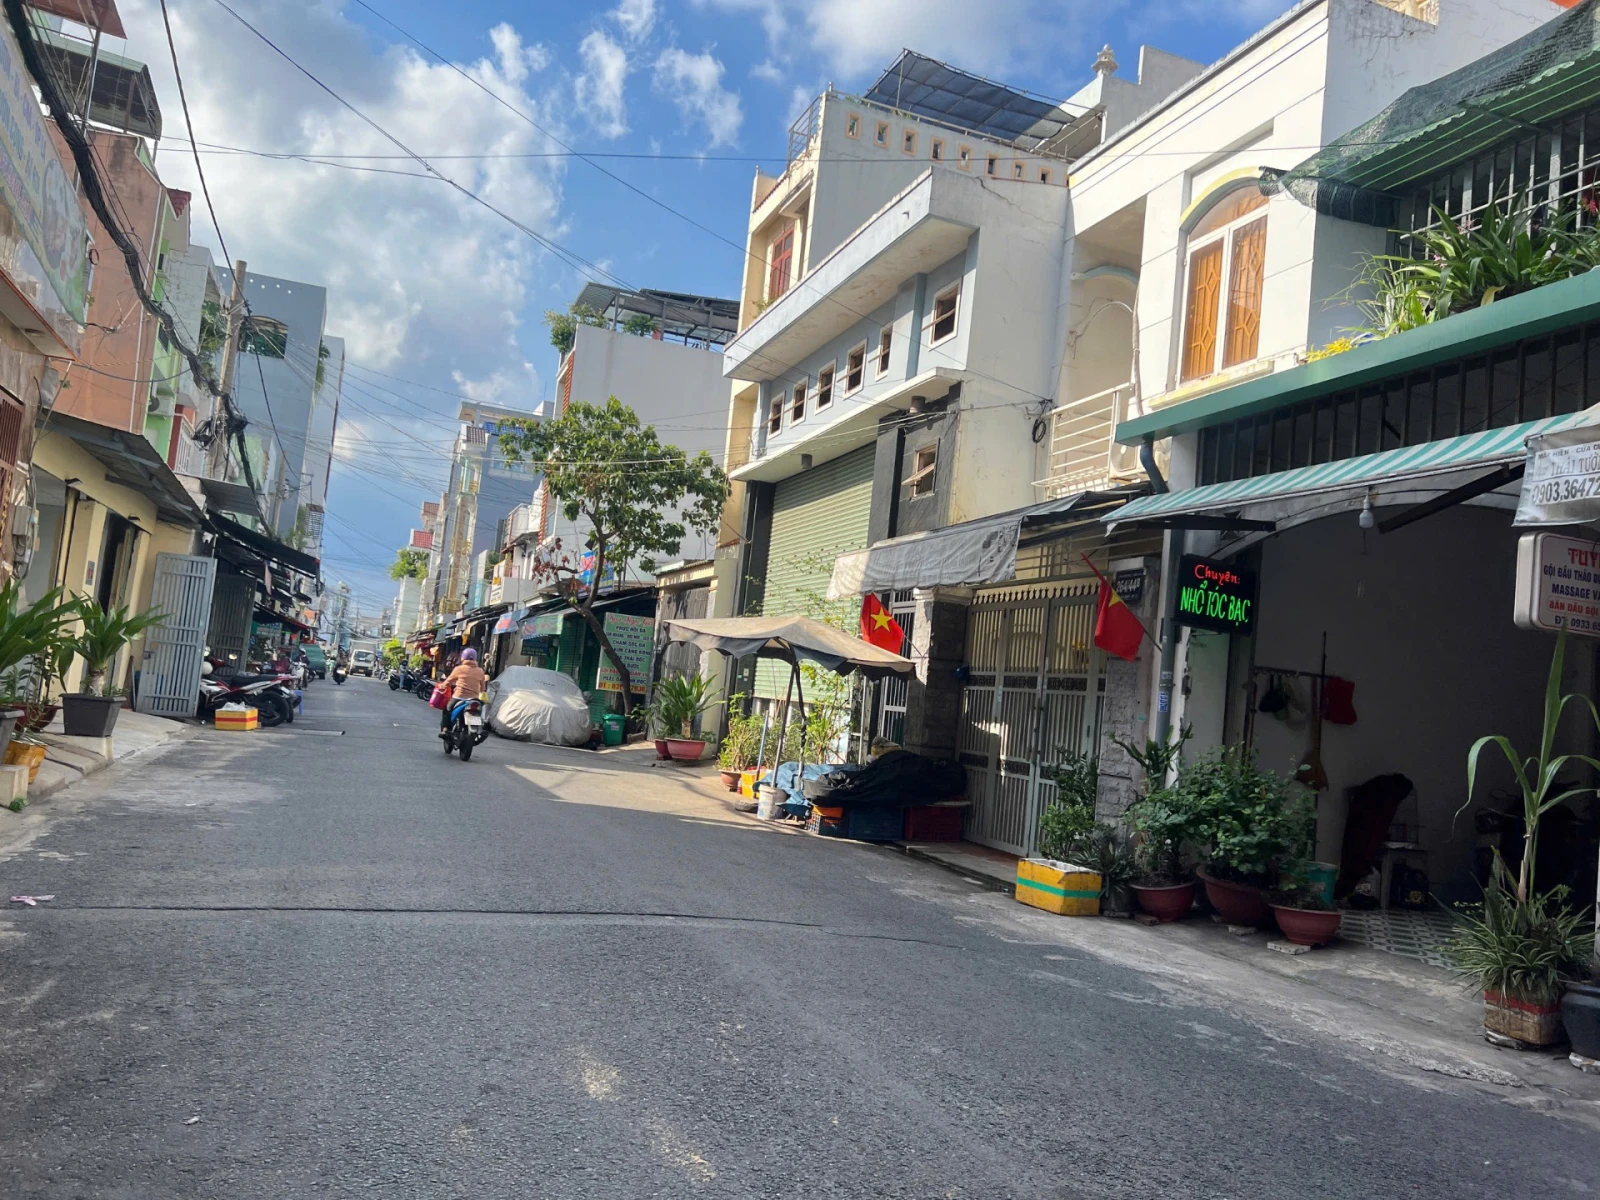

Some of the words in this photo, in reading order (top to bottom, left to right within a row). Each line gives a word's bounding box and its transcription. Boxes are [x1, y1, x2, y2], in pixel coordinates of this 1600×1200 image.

[1568, 547, 1600, 568] TUY
[1552, 583, 1590, 599] MASSAGE
[1180, 580, 1208, 614] NHỔ
[1206, 586, 1227, 618] TÓC
[1228, 595, 1251, 626] BẠC
[1549, 599, 1565, 611] BÁN
[1571, 618, 1590, 629] 0933
